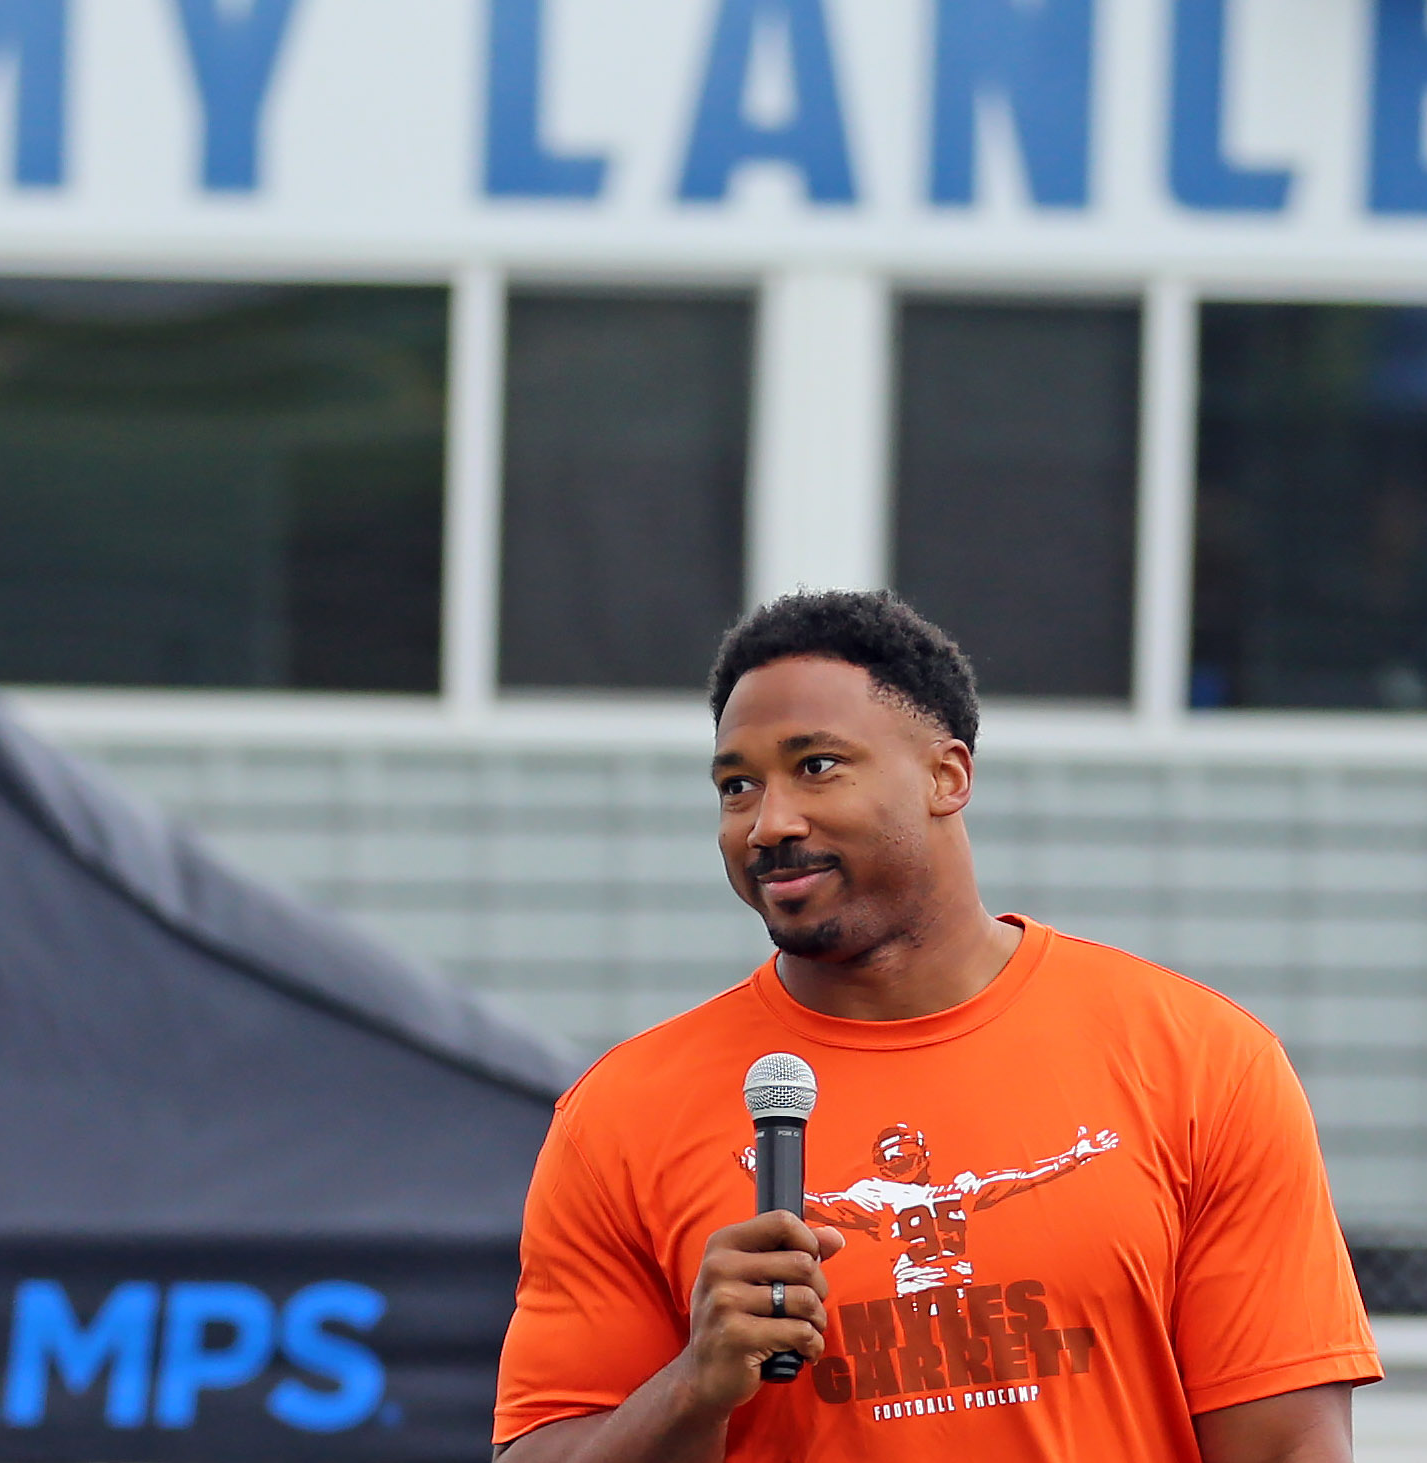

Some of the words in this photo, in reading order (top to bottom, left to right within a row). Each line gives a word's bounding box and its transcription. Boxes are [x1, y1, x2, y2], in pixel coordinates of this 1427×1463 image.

[838, 1280, 1049, 1356] MYLES
[812, 1327, 1095, 1404] GARRETT
[873, 1394, 956, 1422] FOOTBALL
[964, 1385, 1041, 1410] PROCAMP
